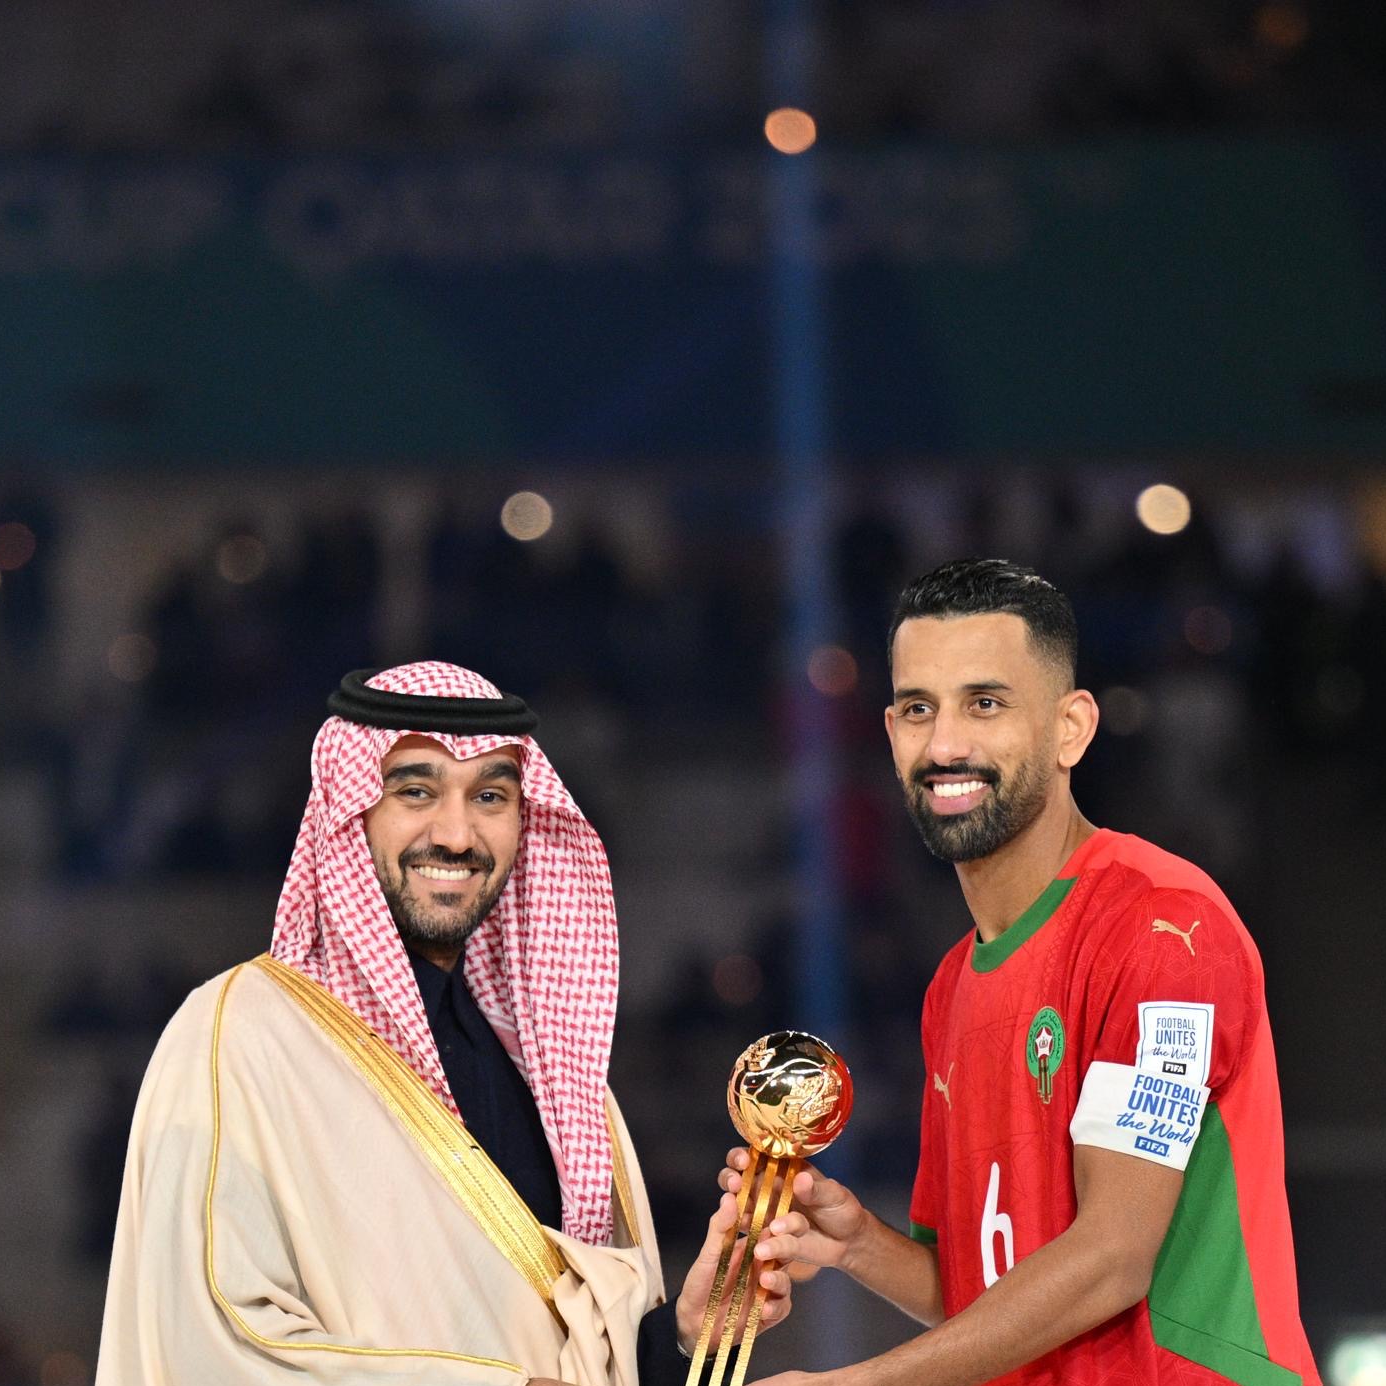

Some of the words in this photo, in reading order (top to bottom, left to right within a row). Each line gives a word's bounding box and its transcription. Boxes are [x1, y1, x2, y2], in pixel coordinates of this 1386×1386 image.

[1156, 1017, 1196, 1030] FOOTBALL
[1155, 1030, 1196, 1047] UNITES
[1152, 1046, 1170, 1057] the
[1170, 1047, 1198, 1062] World
[1164, 1062, 1185, 1074] FIFA
[1134, 1074, 1201, 1106] FOOTBALL
[1127, 1090, 1199, 1127] UNITES
[1116, 1112, 1147, 1130] the
[1149, 1119, 1196, 1147] World
[1137, 1138, 1167, 1155] FIFA
[980, 1161, 1015, 1290] 6
